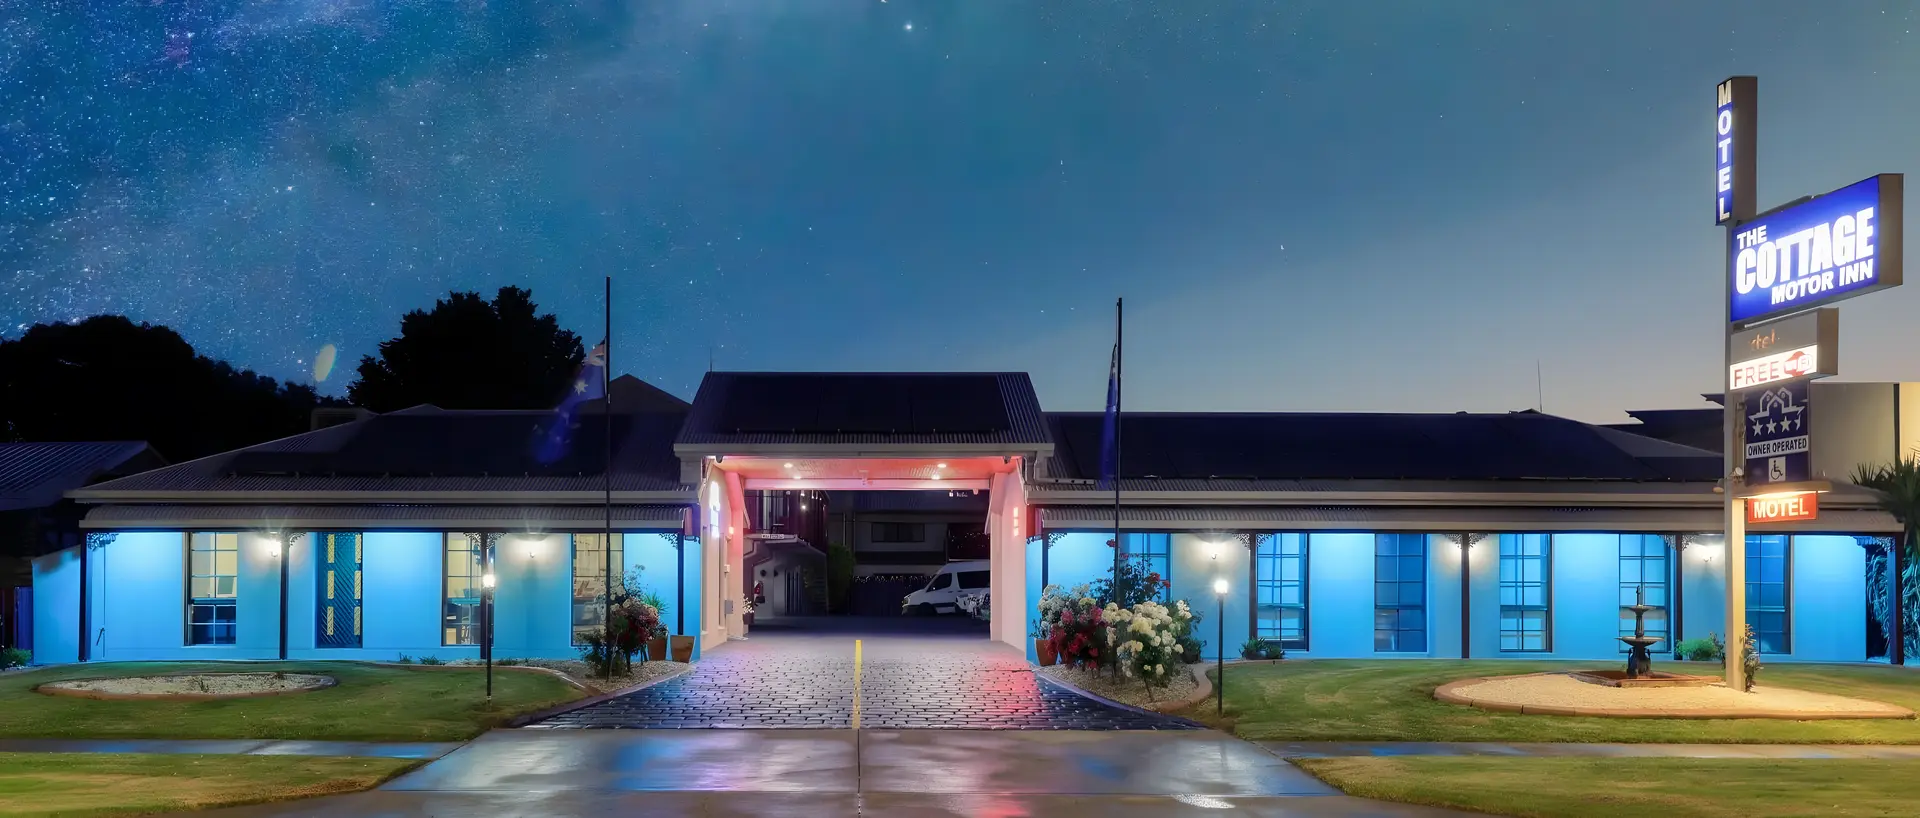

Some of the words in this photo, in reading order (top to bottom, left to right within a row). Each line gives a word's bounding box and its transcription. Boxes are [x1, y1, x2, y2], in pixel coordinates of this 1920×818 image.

[1718, 80, 1732, 221] MOTEL
[1736, 207, 1874, 294] COTTAGE
[1737, 225, 1767, 250] THE
[1771, 272, 1834, 305] MOTOR
[1839, 259, 1874, 286] INN
[1734, 361, 1780, 387] FREE
[1748, 442, 1771, 456] OWNER
[1772, 438, 1807, 453] OPERATED
[1753, 498, 1809, 518] MOTEL
